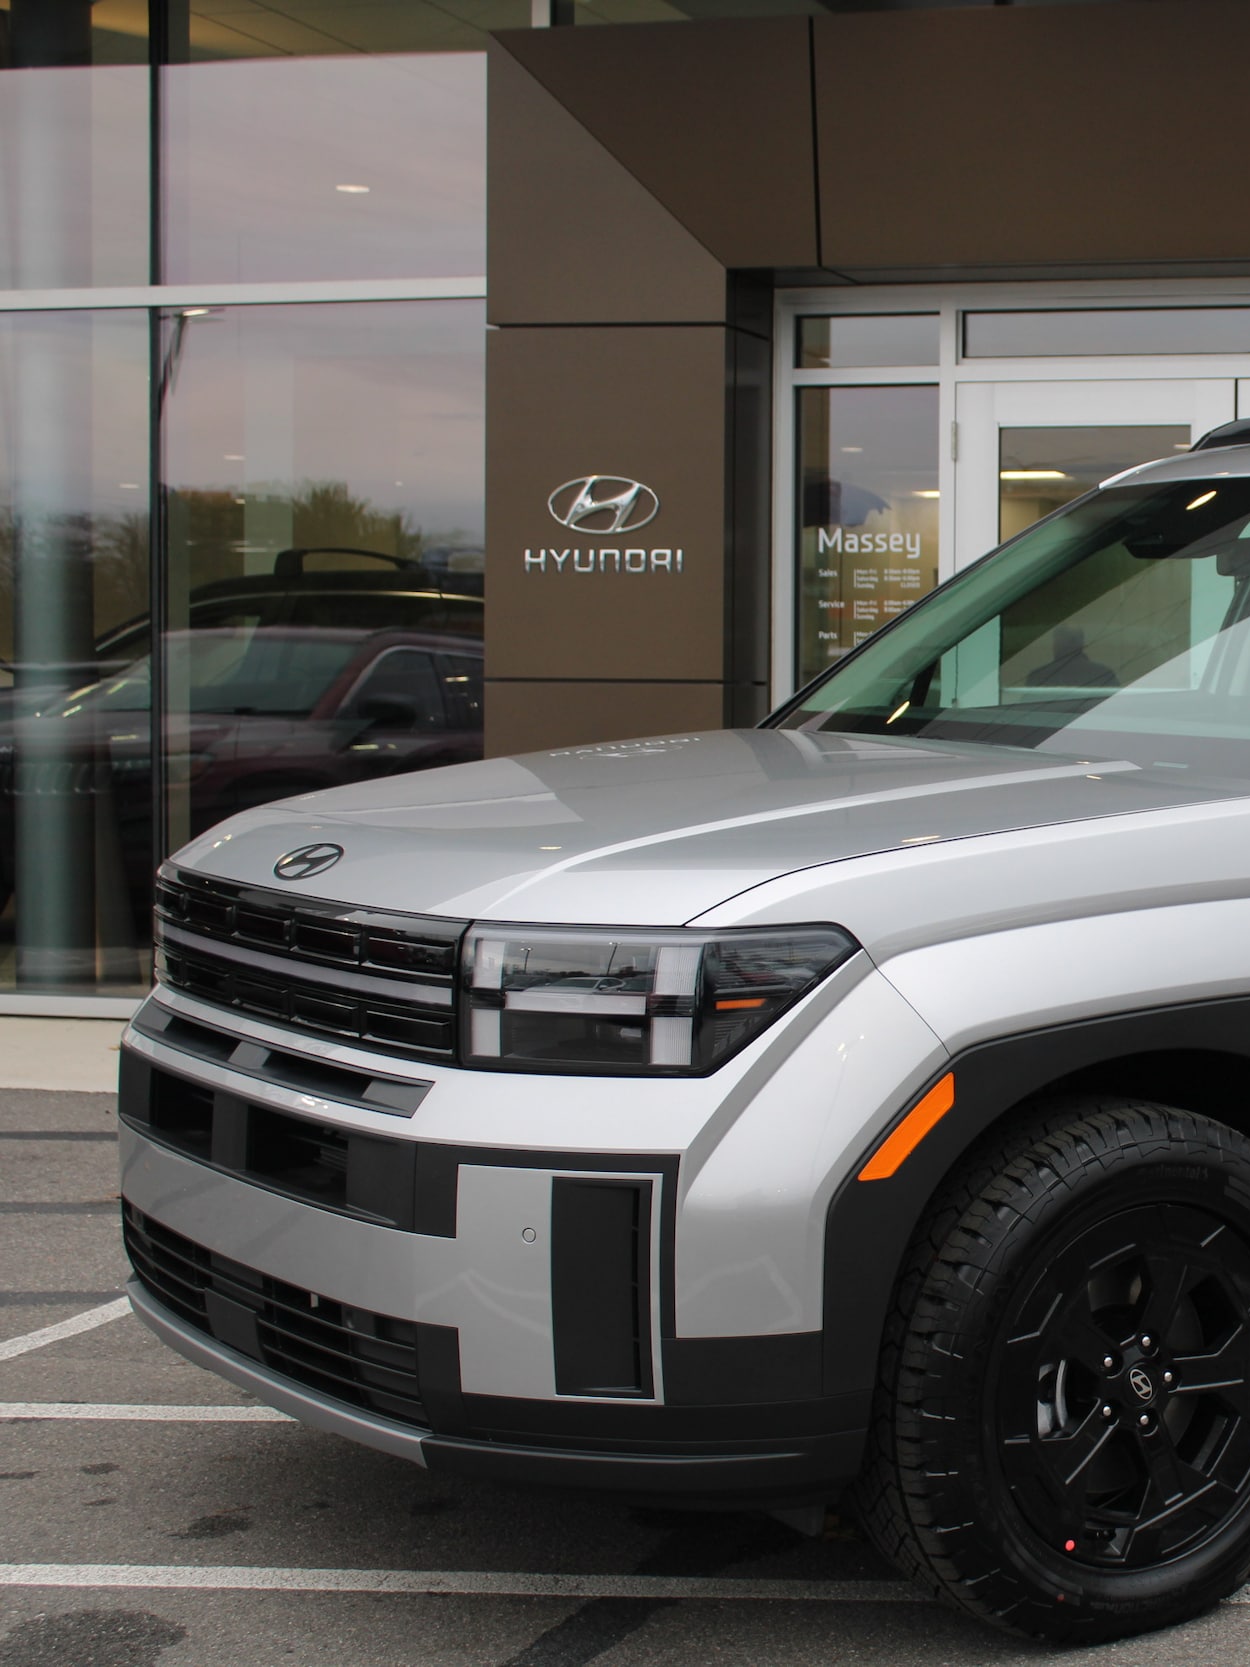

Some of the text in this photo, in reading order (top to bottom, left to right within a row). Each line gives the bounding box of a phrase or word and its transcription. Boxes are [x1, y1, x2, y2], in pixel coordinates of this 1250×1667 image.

[818, 527, 920, 559] Massey
[524, 548, 683, 573] HYUNDAI
[818, 568, 838, 577] Sales
[818, 599, 845, 609] Service
[818, 631, 838, 639] Parts
